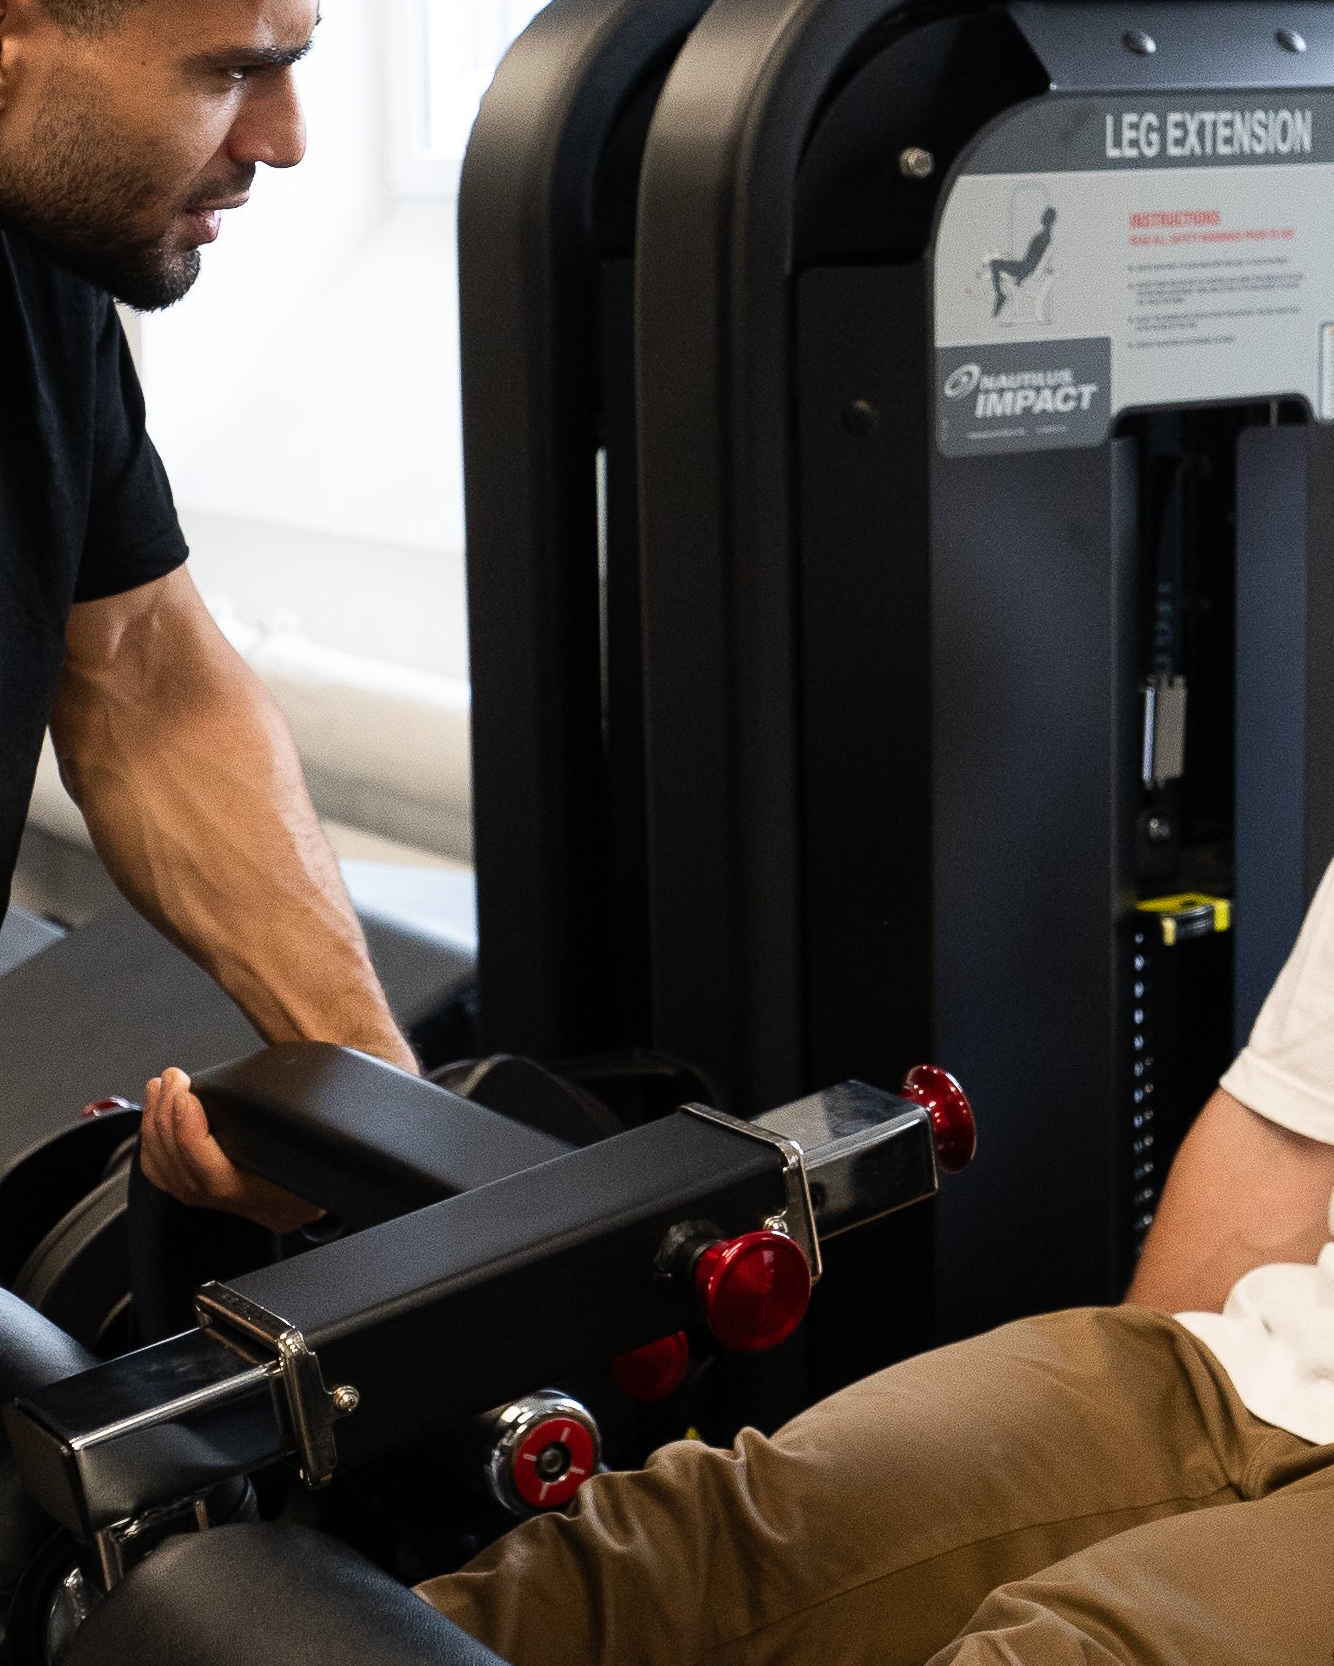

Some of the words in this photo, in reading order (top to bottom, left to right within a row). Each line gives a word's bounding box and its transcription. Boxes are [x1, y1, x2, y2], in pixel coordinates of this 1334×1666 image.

[1104, 111, 1161, 159] LEG
[1167, 108, 1313, 157] EXTENSION
[1129, 210, 1220, 229] INSTRUCTIONS
[979, 369, 1074, 390] NAUTILUS
[974, 383, 1099, 419] IMPACT
